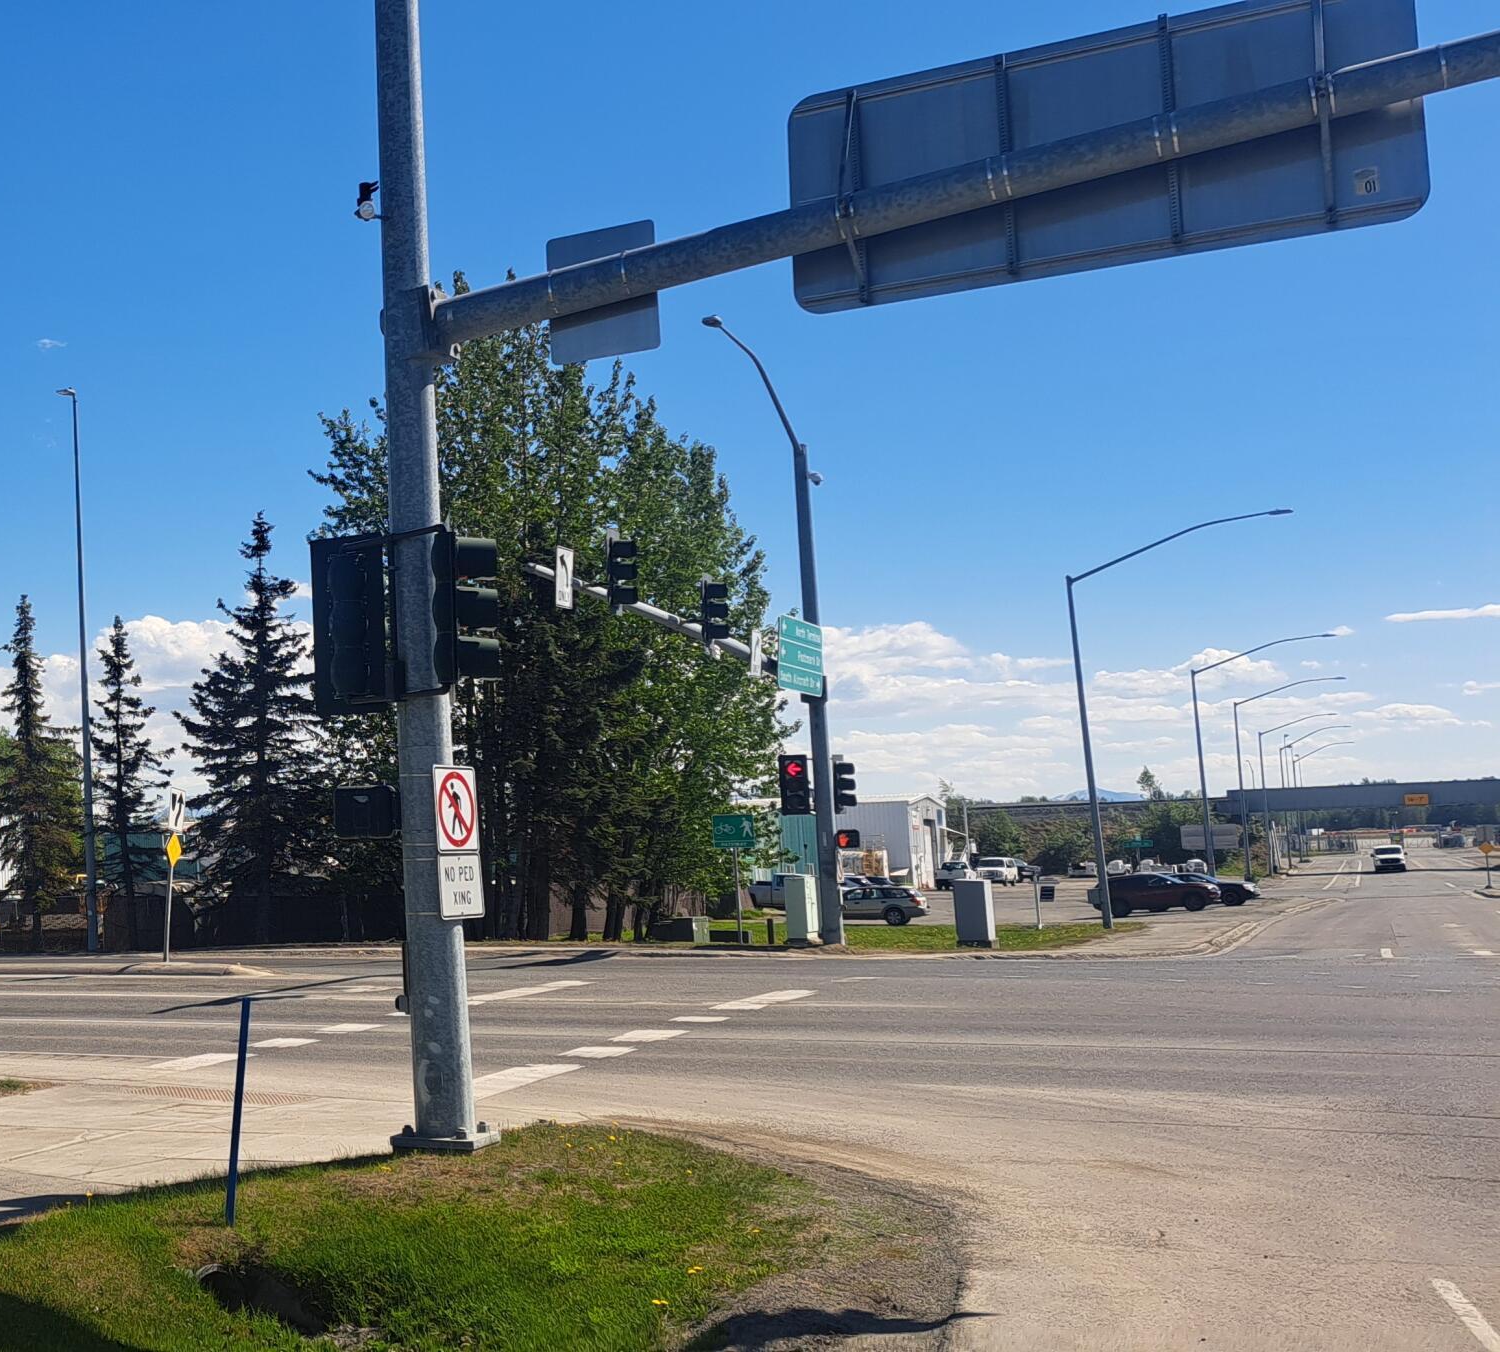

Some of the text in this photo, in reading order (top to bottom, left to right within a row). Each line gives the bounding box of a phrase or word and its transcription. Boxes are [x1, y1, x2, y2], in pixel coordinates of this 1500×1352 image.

[445, 866, 474, 882] NO PED
[453, 890, 471, 906] XING
